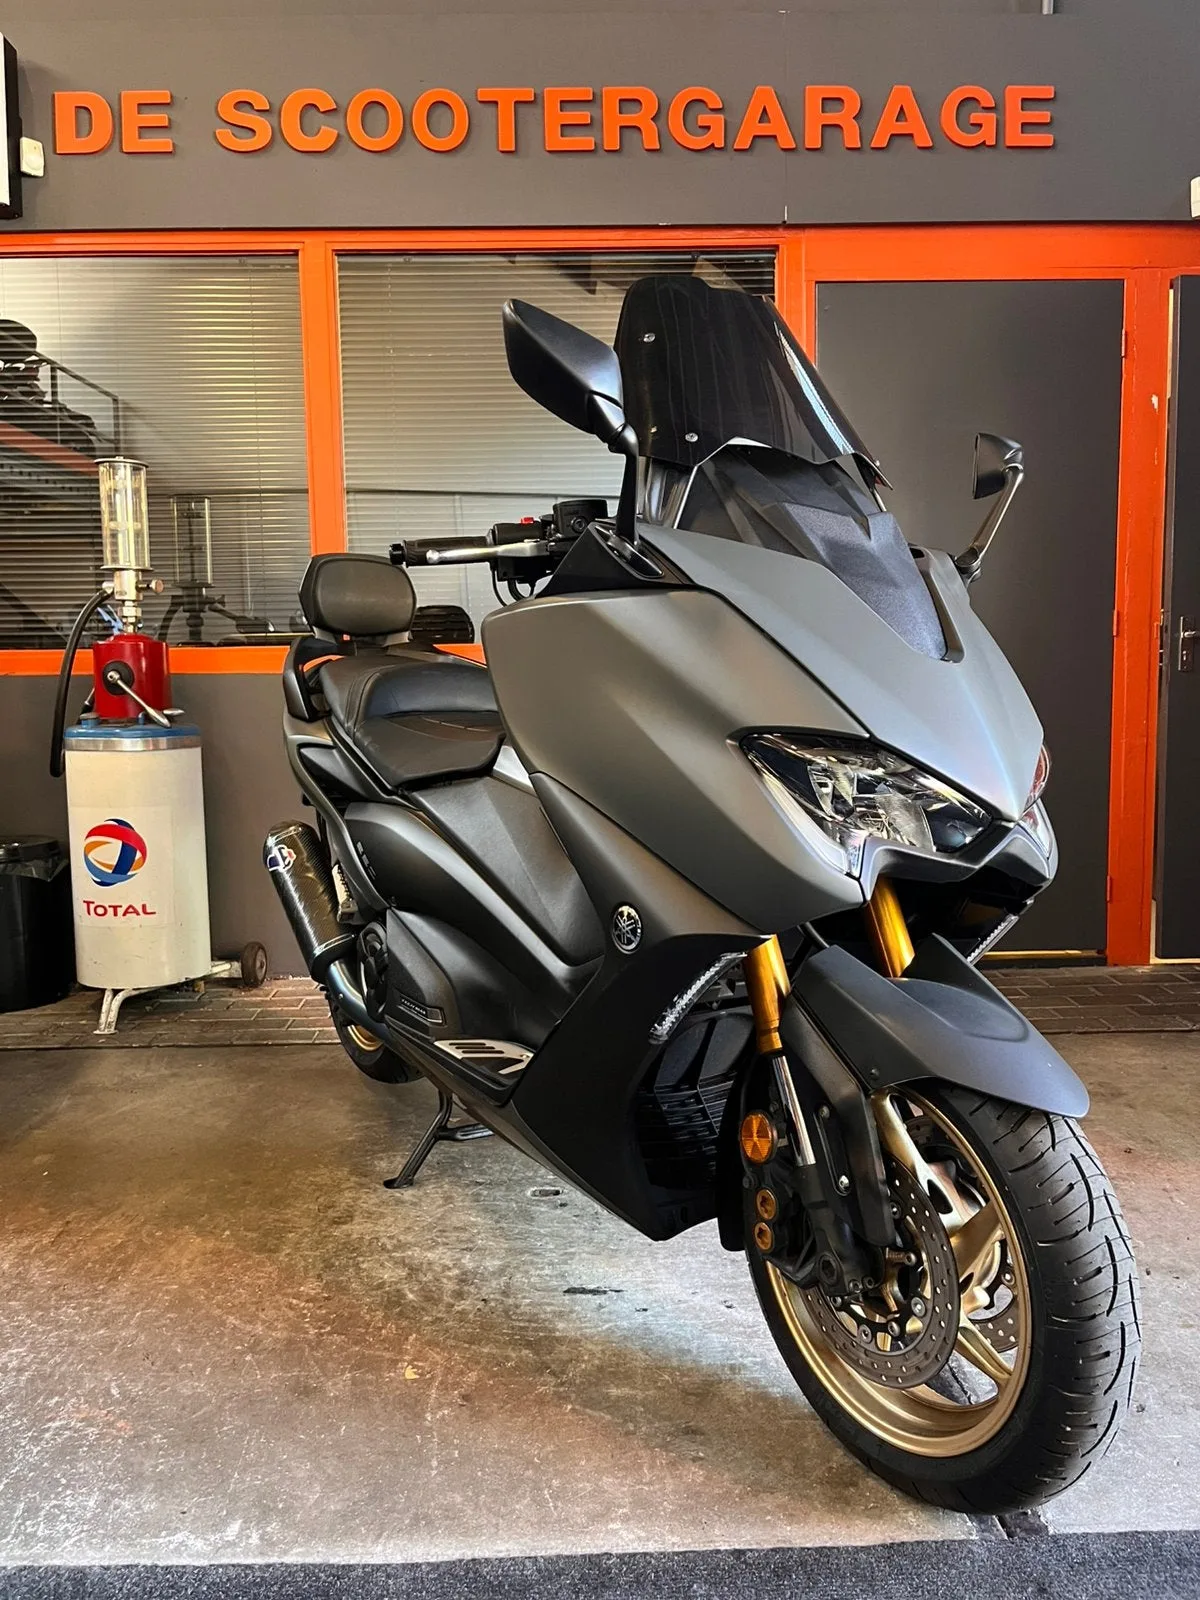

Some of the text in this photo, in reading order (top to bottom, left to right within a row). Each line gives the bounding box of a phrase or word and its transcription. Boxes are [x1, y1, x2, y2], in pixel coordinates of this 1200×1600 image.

[54, 85, 1055, 153] DE SCOOTERGARAGE
[83, 900, 156, 917] TOTAL
